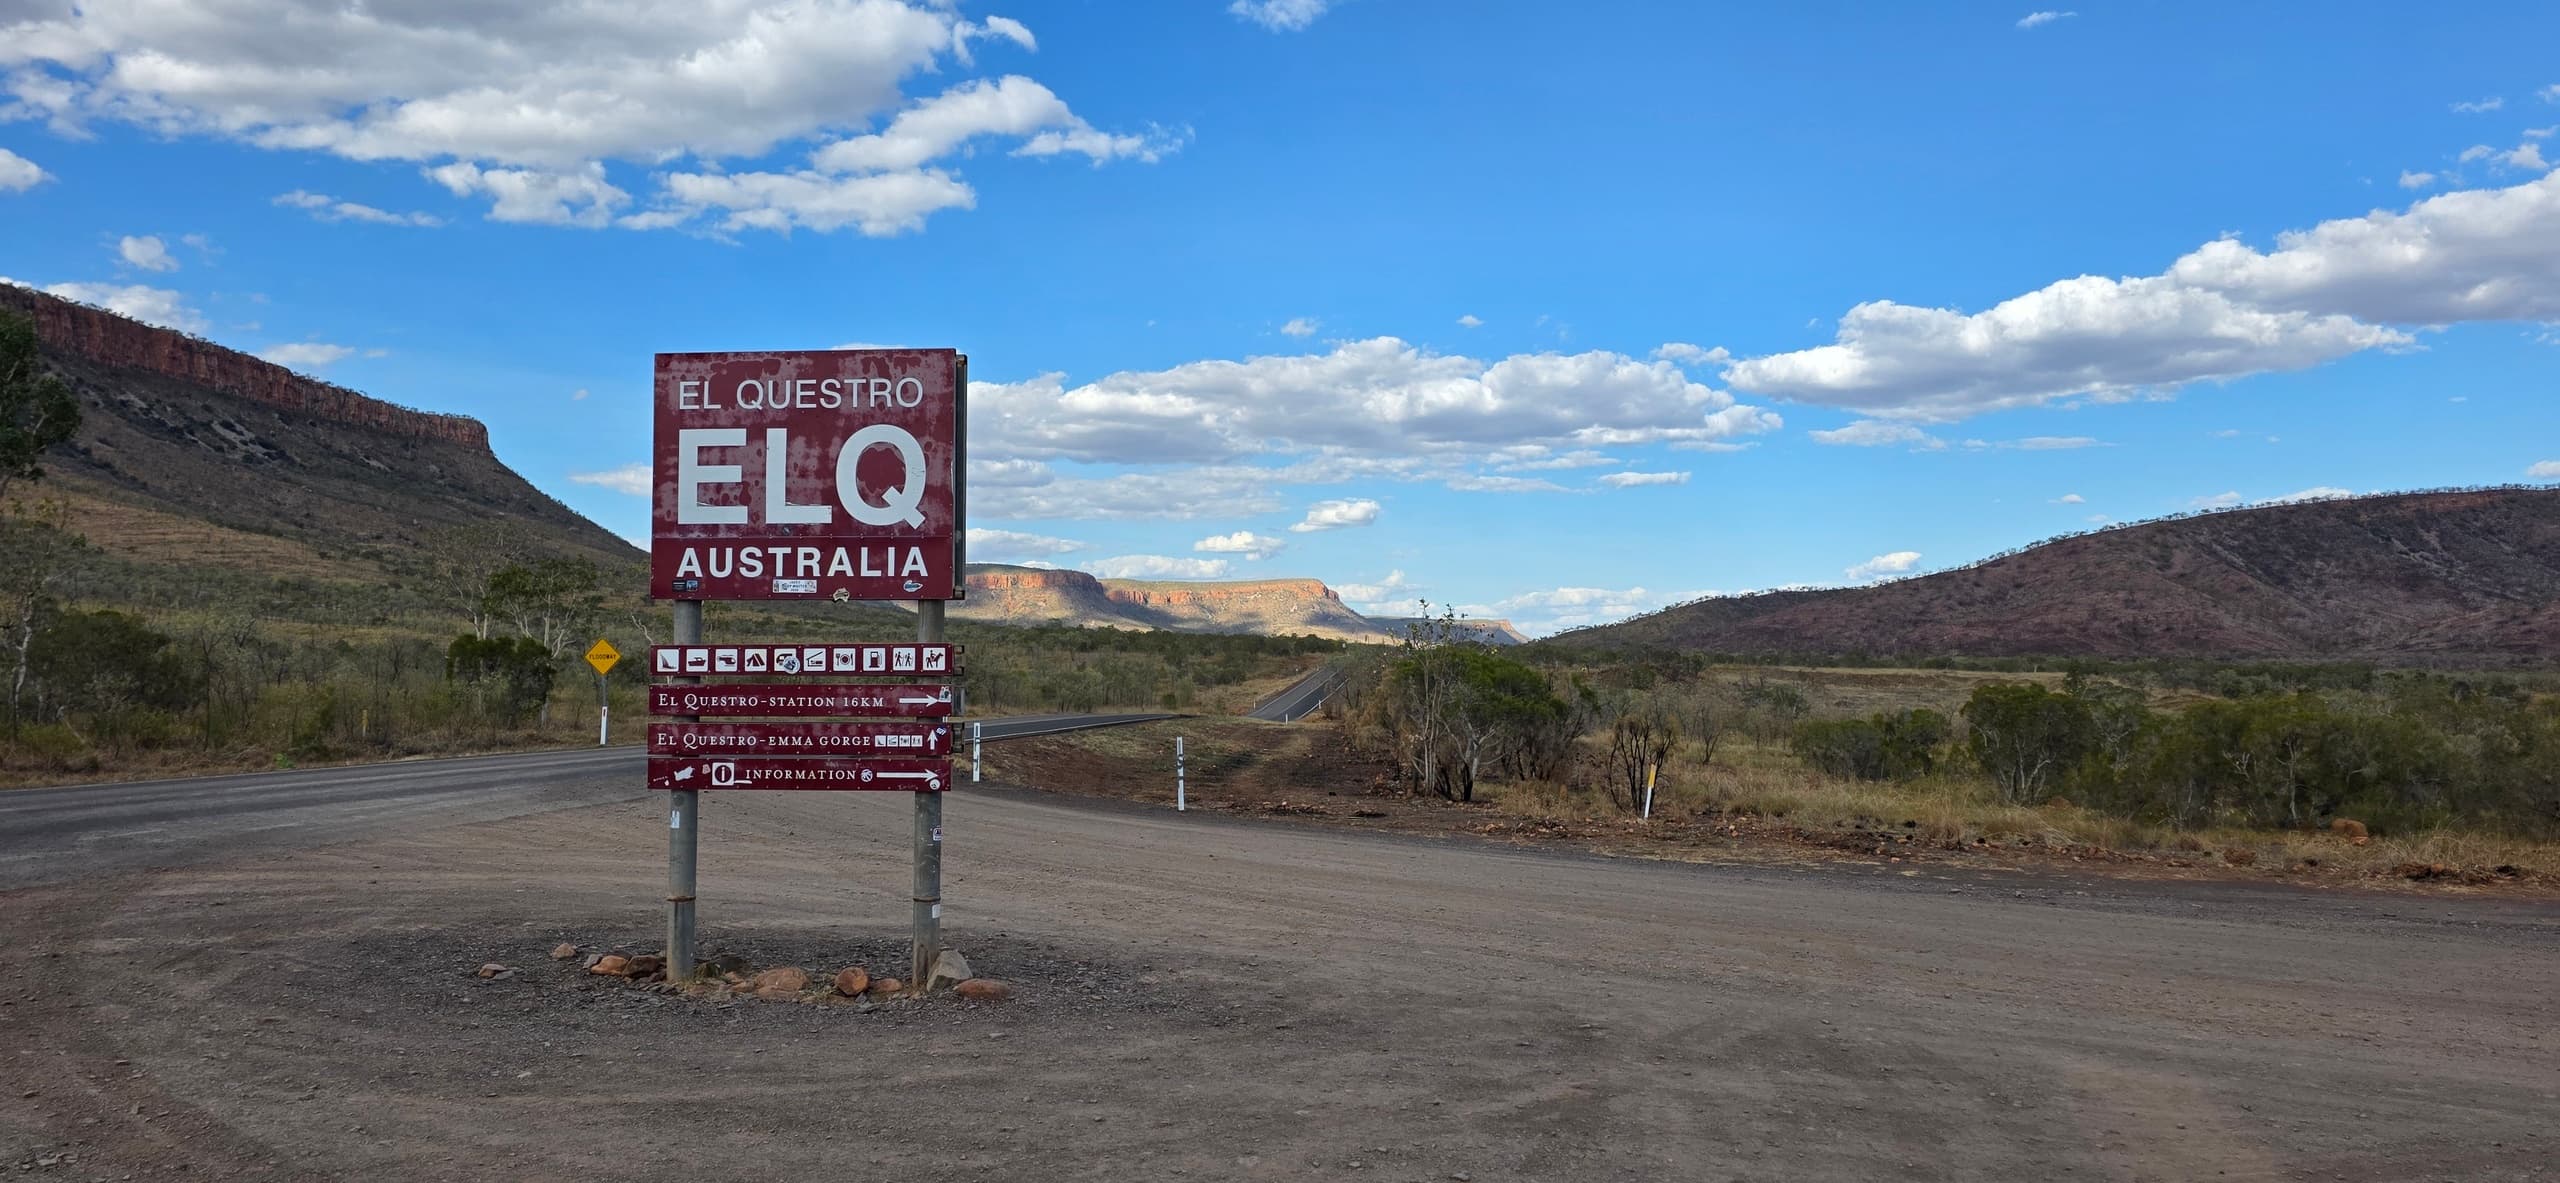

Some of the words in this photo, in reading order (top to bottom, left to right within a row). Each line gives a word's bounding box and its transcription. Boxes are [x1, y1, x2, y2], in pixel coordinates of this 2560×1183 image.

[679, 381, 721, 410] EL
[736, 377, 924, 411] QUESTRO
[677, 424, 927, 530] ELQ
[676, 546, 929, 578] AUSTRALIA
[843, 697, 884, 707] 16KM
[819, 736, 871, 746] GORGE
[746, 769, 857, 780] INFORMATION
